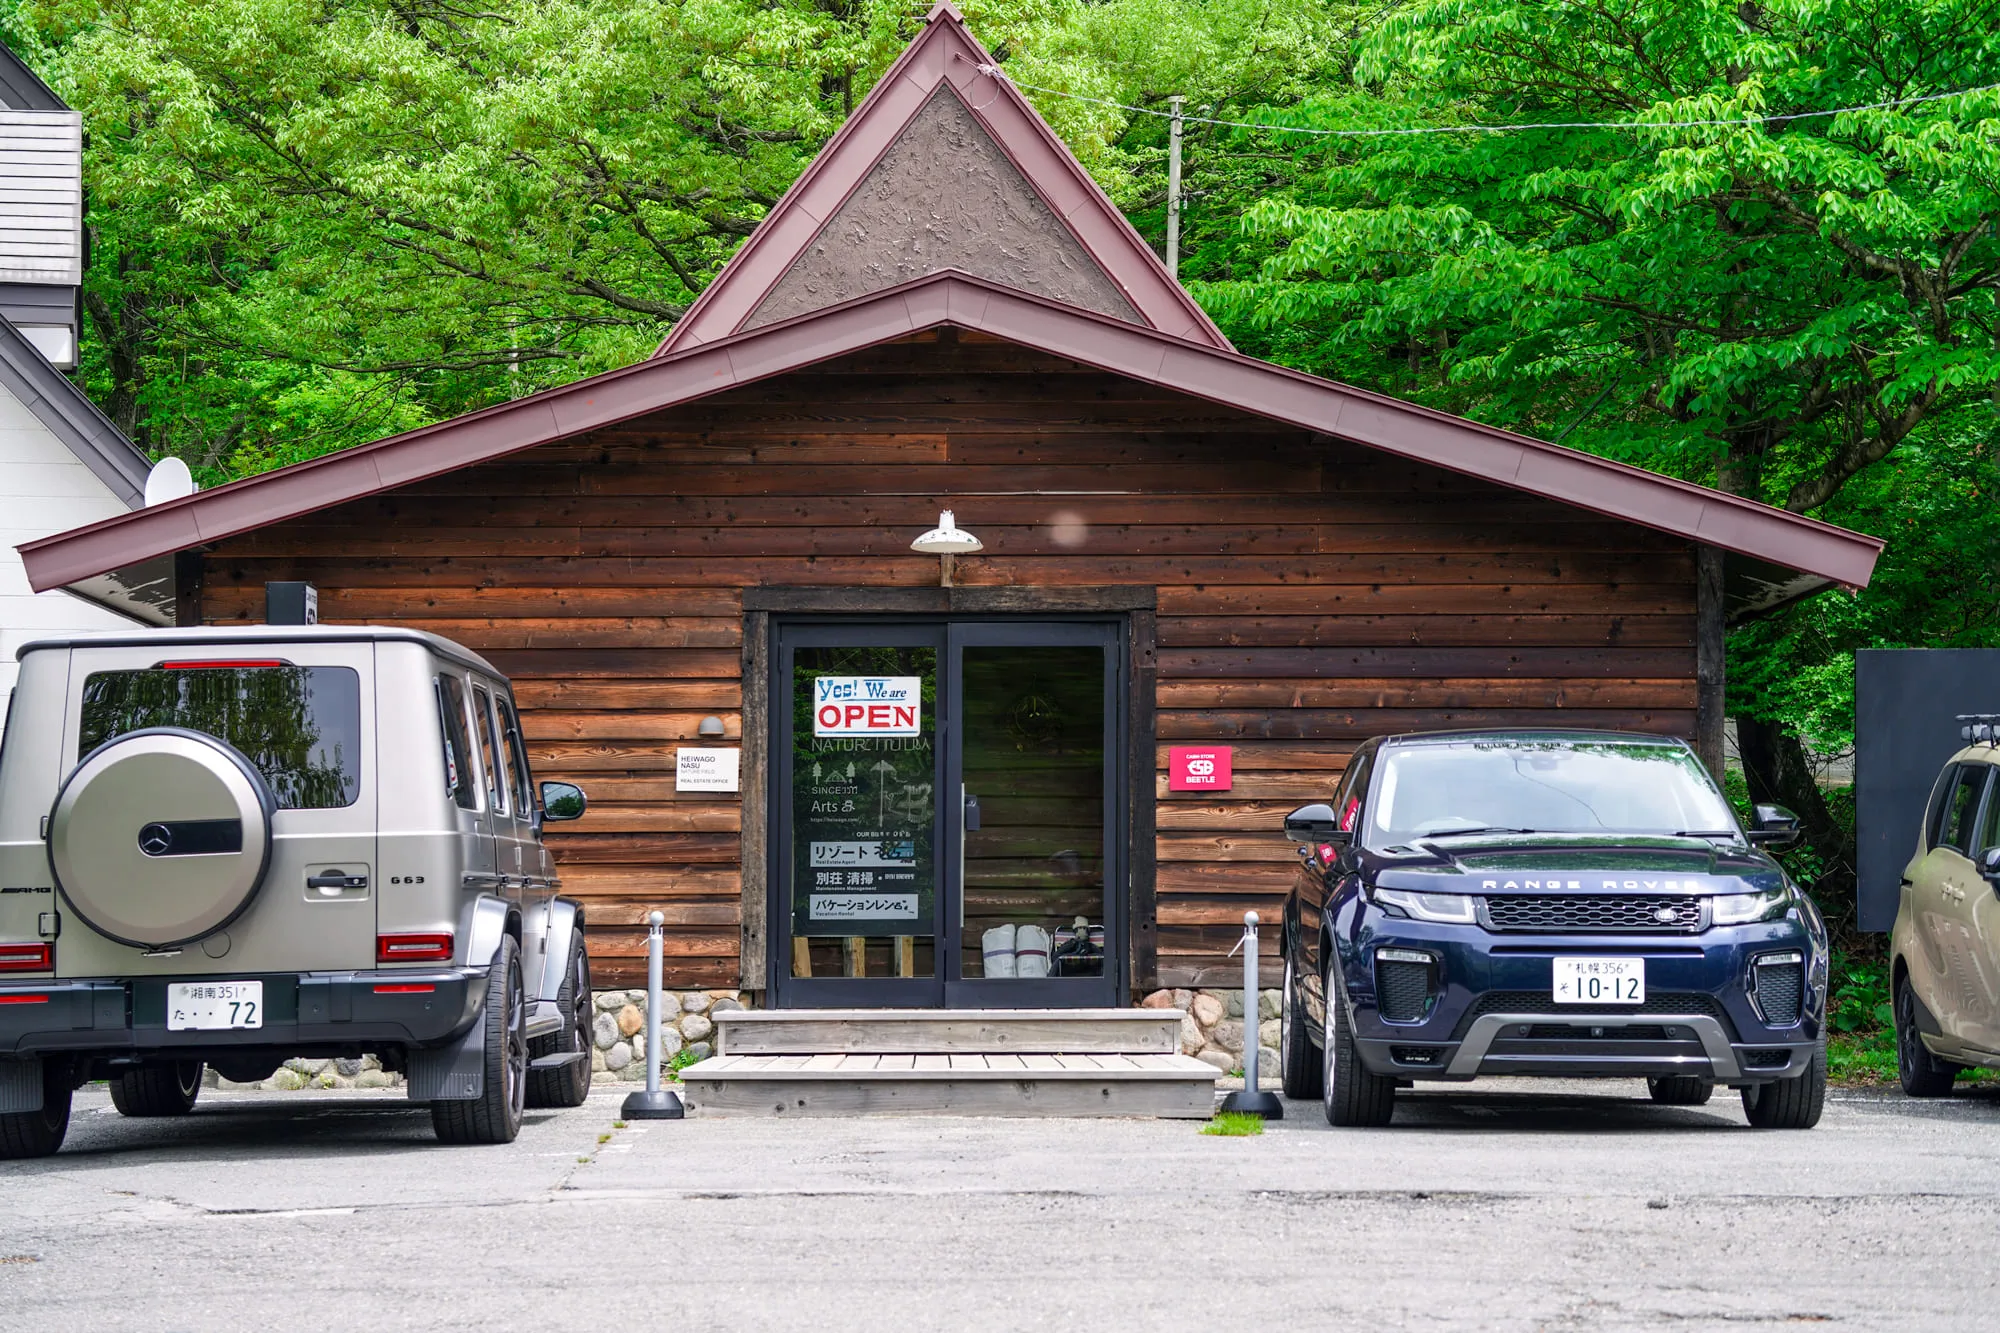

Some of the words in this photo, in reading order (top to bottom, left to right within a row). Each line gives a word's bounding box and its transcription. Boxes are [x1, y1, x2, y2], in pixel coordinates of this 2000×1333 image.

[818, 680, 857, 701] Yes!
[865, 682, 887, 698] We
[889, 689, 907, 698] are
[818, 705, 916, 728] OPEN
[1186, 776, 1216, 784] BEETLE
[811, 786, 841, 795] SINCE
[811, 800, 838, 813] Arts
[816, 846, 868, 859] リゾート
[816, 872, 843, 885] 別荘
[847, 872, 873, 885] 清掃
[1482, 880, 1581, 889] RANGE
[1602, 880, 1700, 889] ROVER
[1577, 977, 1639, 999] 10-12
